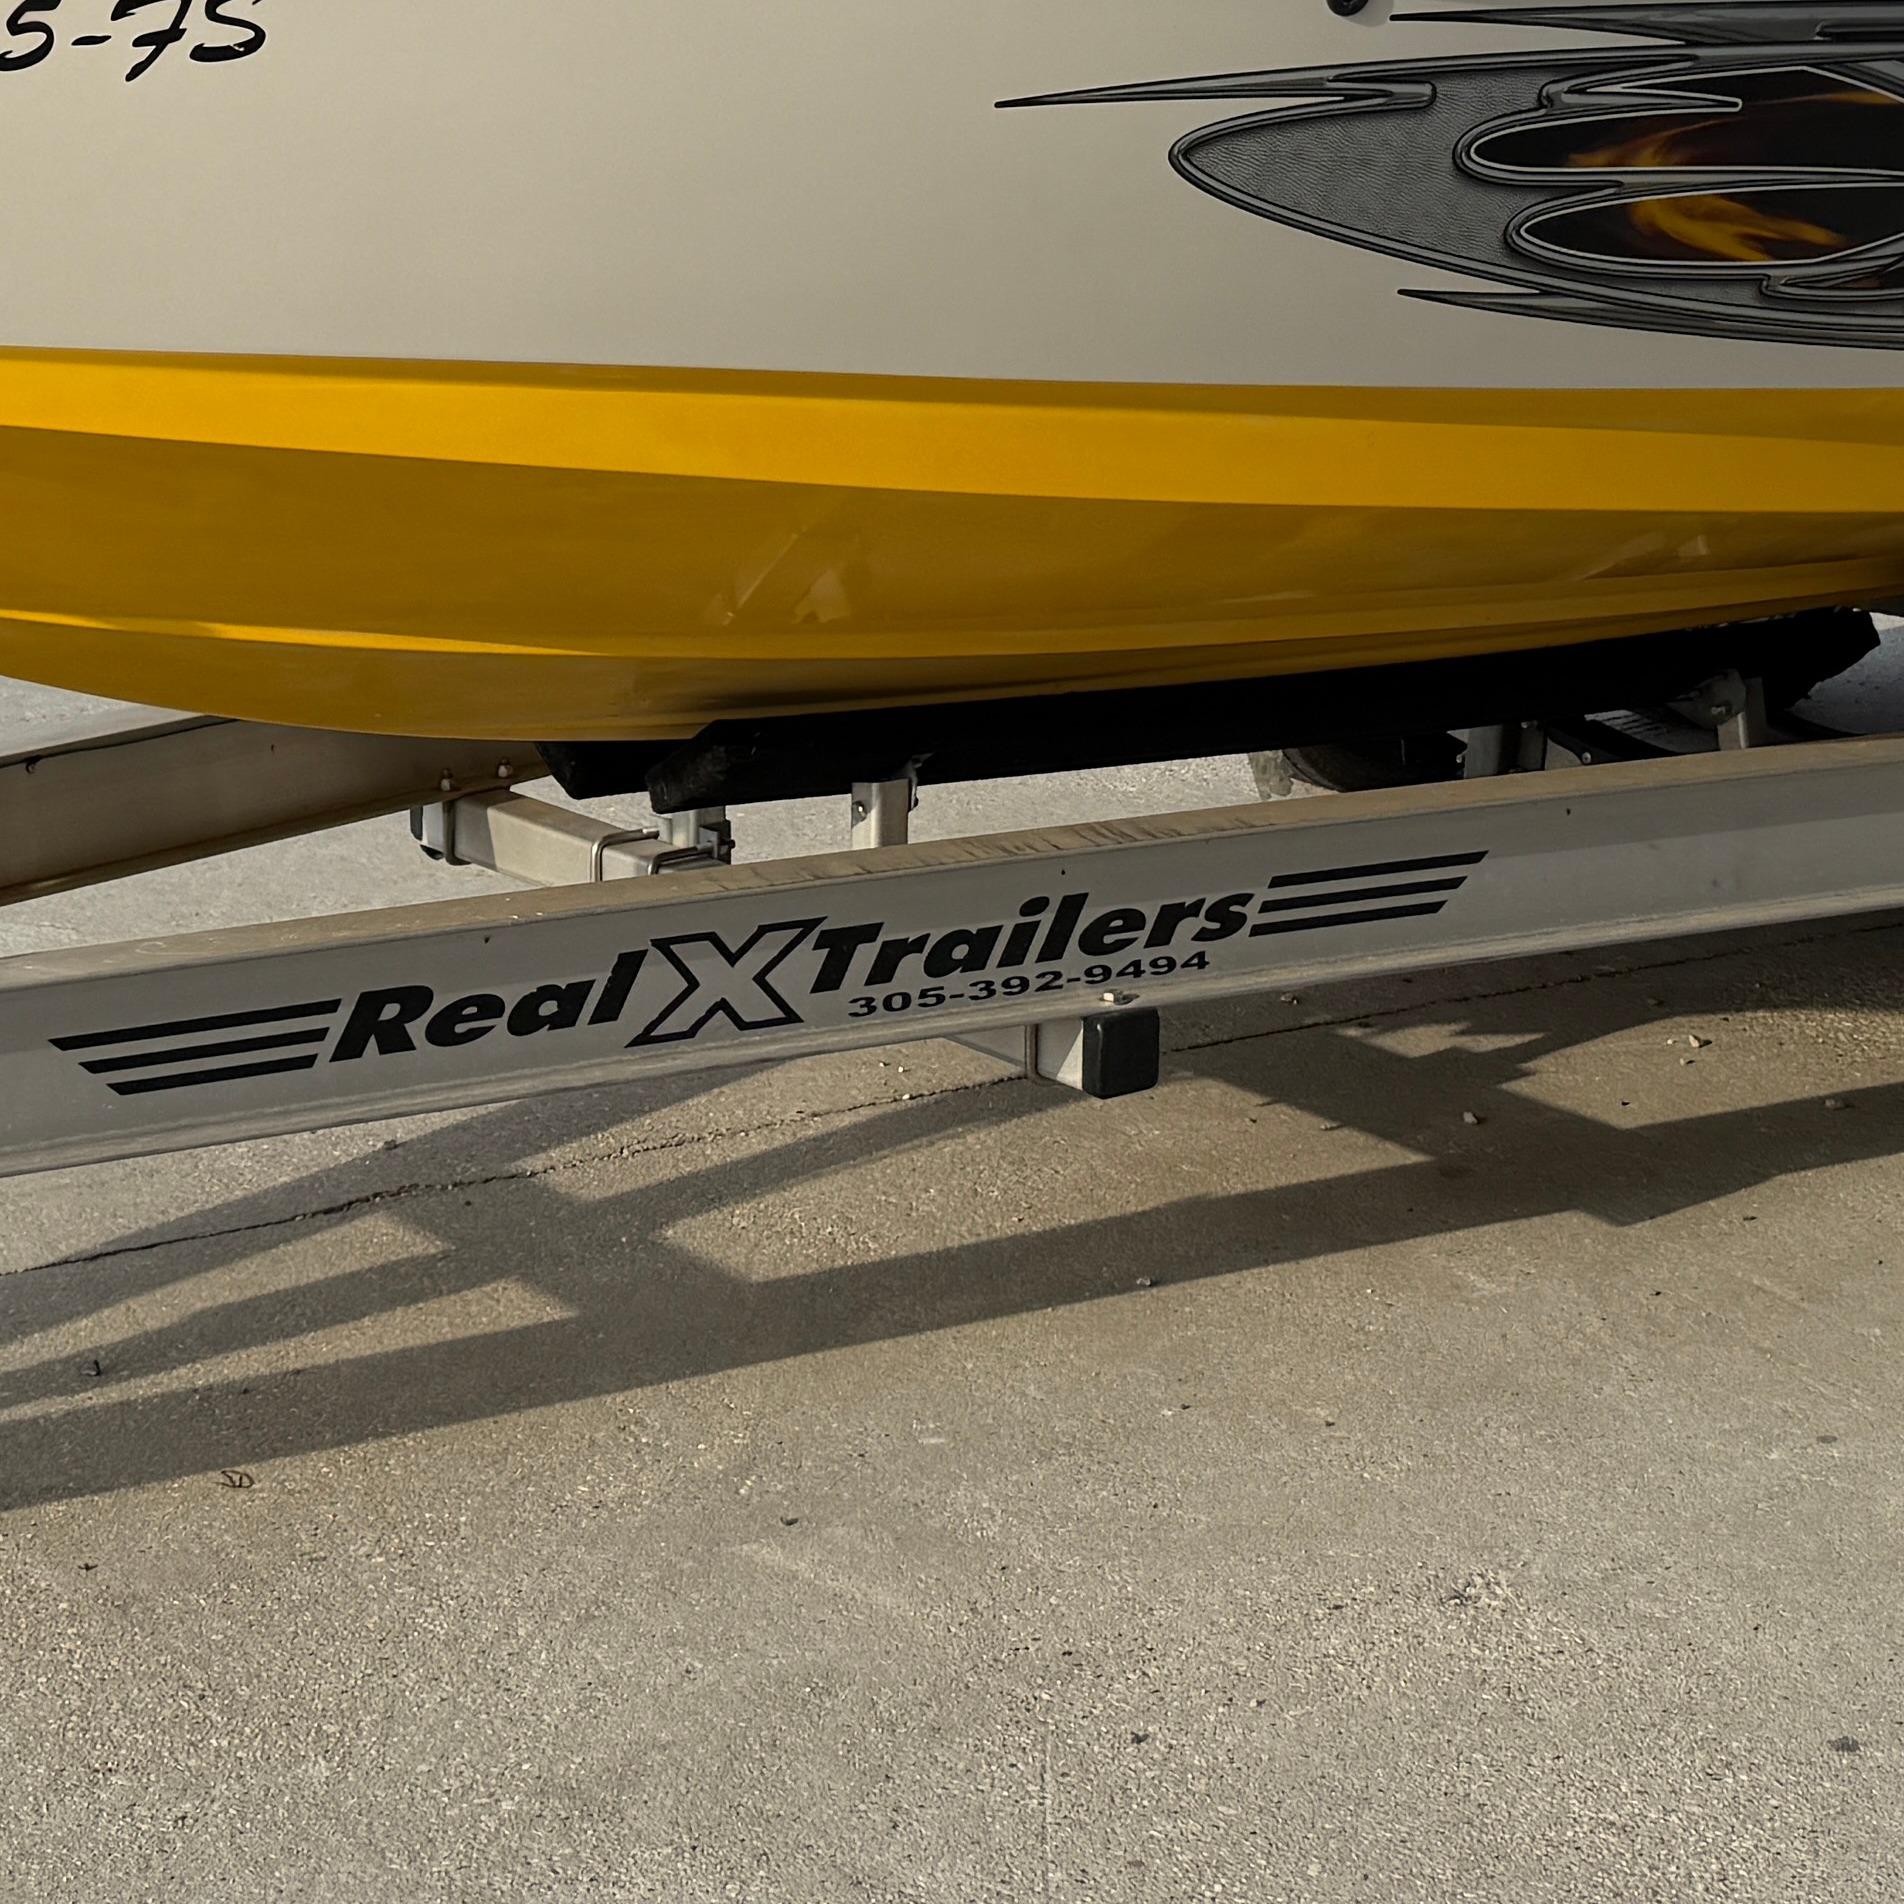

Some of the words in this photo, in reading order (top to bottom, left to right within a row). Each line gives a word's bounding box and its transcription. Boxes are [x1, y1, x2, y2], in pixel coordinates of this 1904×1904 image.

[329, 949, 648, 1063] Real
[624, 916, 828, 1048] X
[810, 892, 1255, 994] Trailers
[847, 950, 1210, 1019] 305-392-9494
